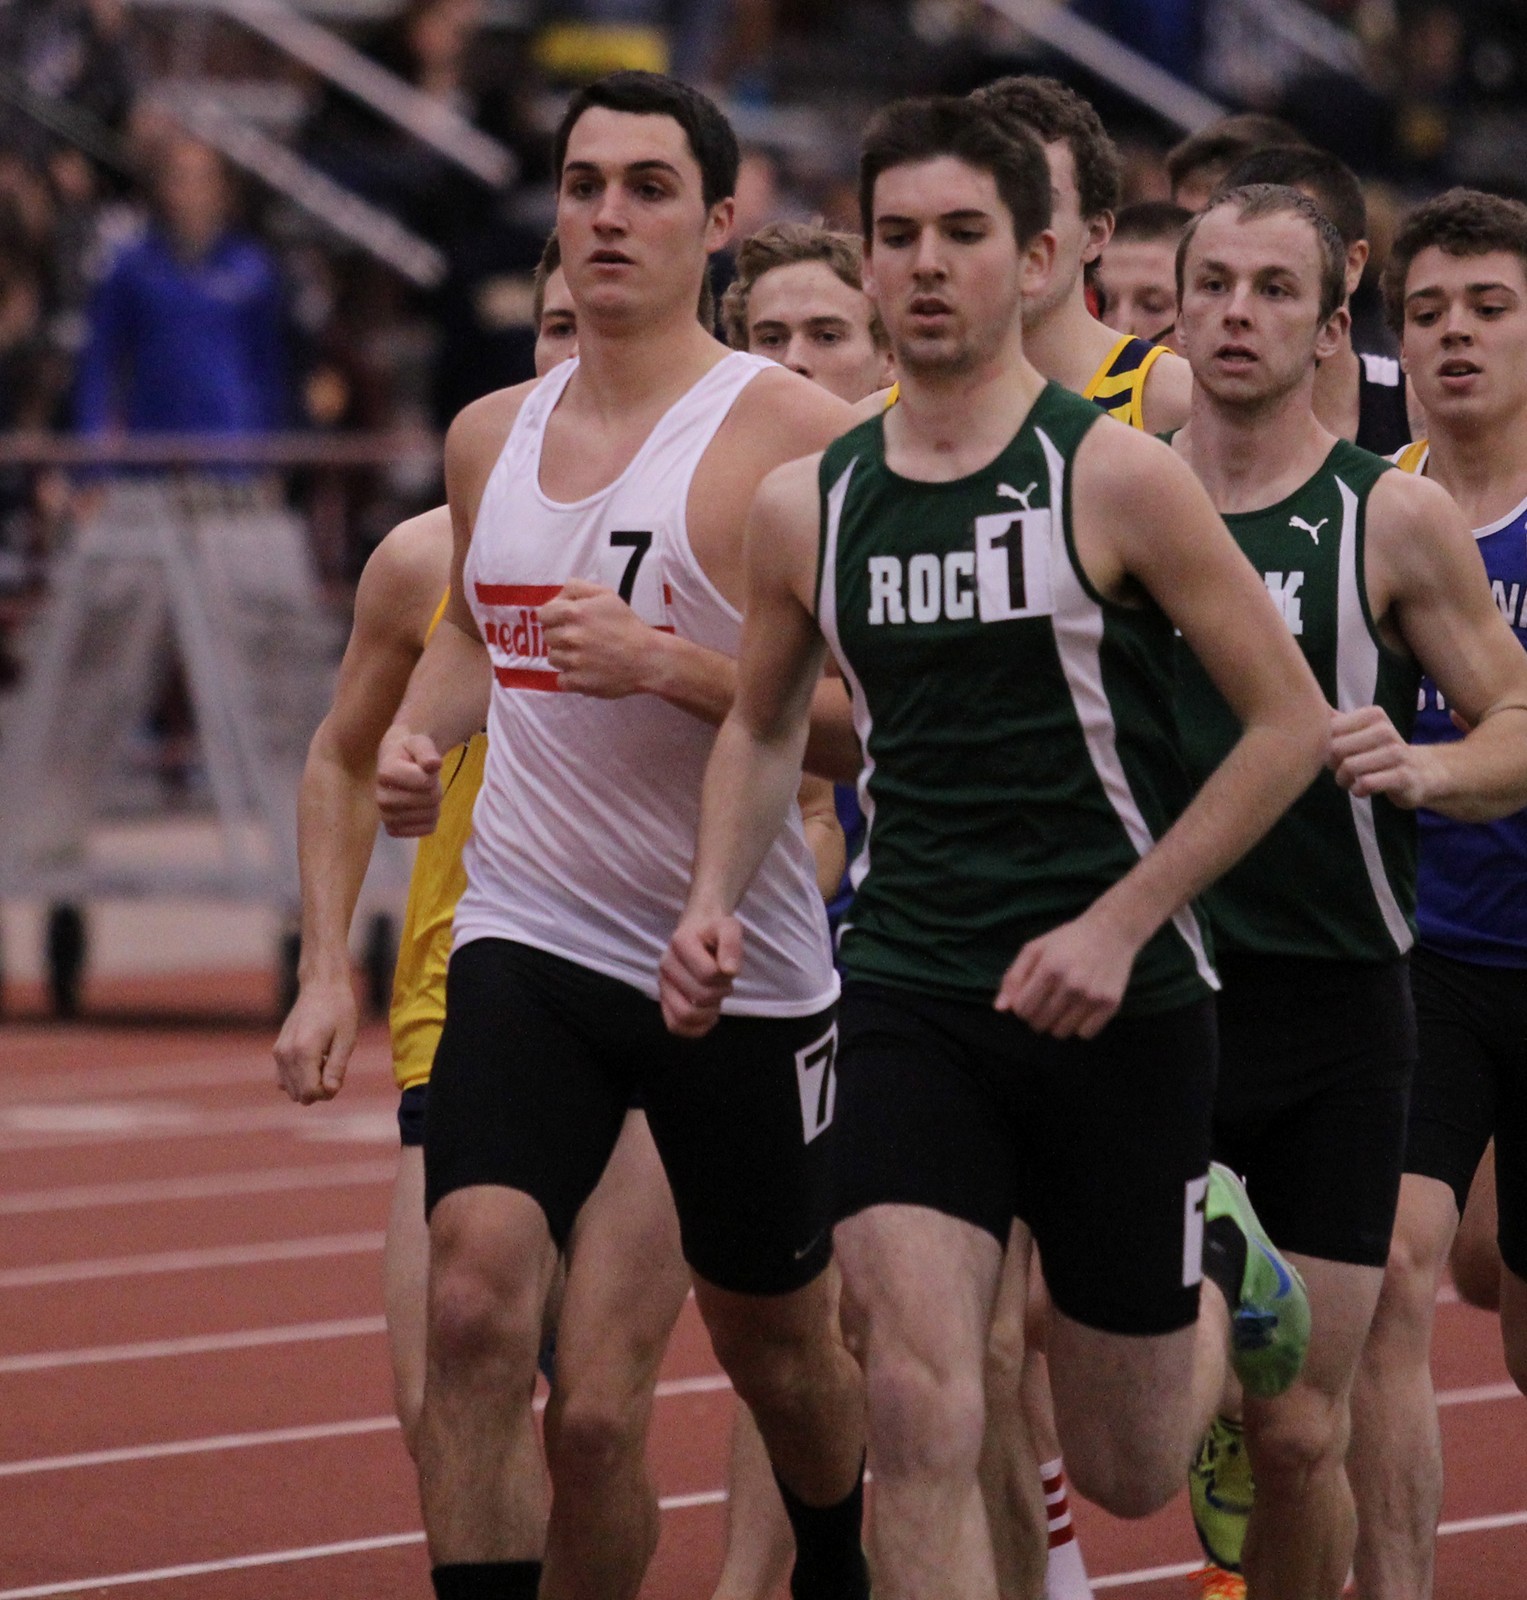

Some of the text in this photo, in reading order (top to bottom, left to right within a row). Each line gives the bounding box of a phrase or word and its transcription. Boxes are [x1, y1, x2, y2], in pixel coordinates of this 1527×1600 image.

[610, 531, 653, 606] 7
[867, 551, 977, 625] ROC
[991, 519, 1027, 611] 1
[804, 1035, 834, 1129] 7
